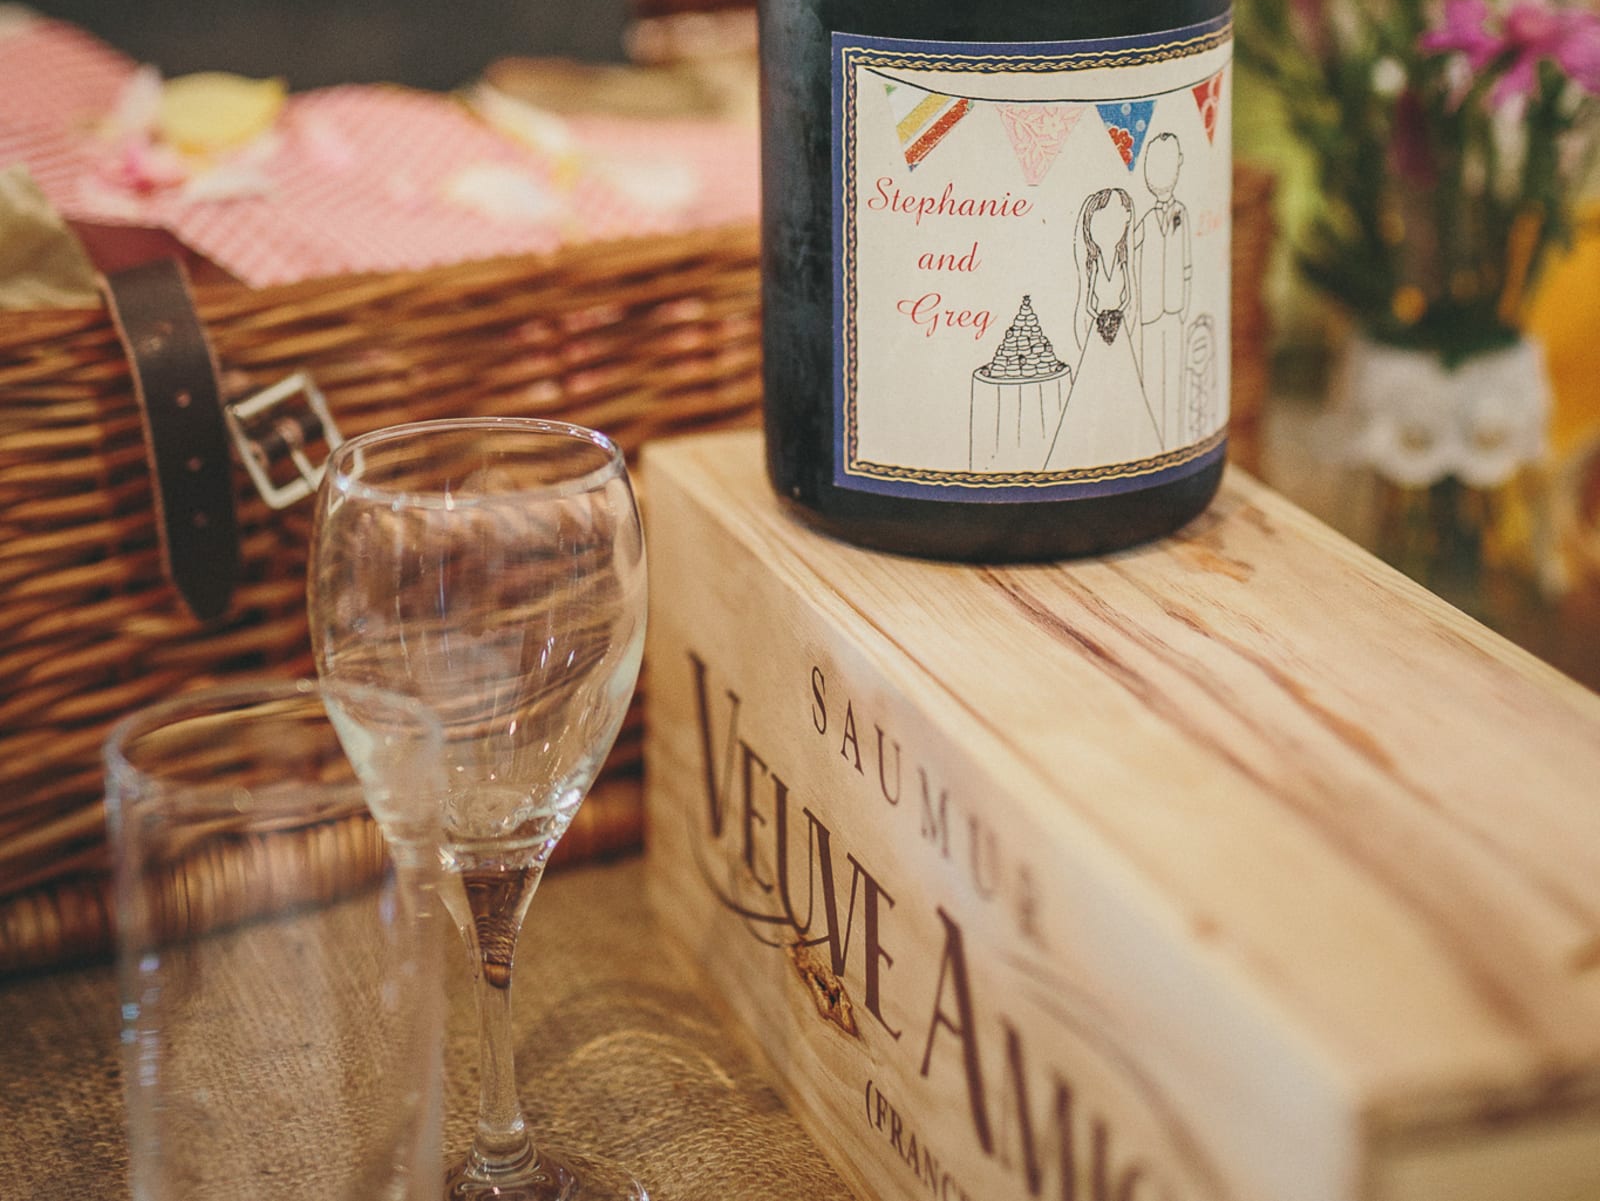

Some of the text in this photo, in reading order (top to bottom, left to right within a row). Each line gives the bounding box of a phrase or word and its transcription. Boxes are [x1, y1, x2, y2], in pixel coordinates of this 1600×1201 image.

[867, 177, 1034, 225] Stephanie
[918, 242, 981, 273] and
[897, 293, 998, 340] Greg
[688, 650, 902, 1041] VEUVE
[866, 1080, 970, 1201] (FRANC
